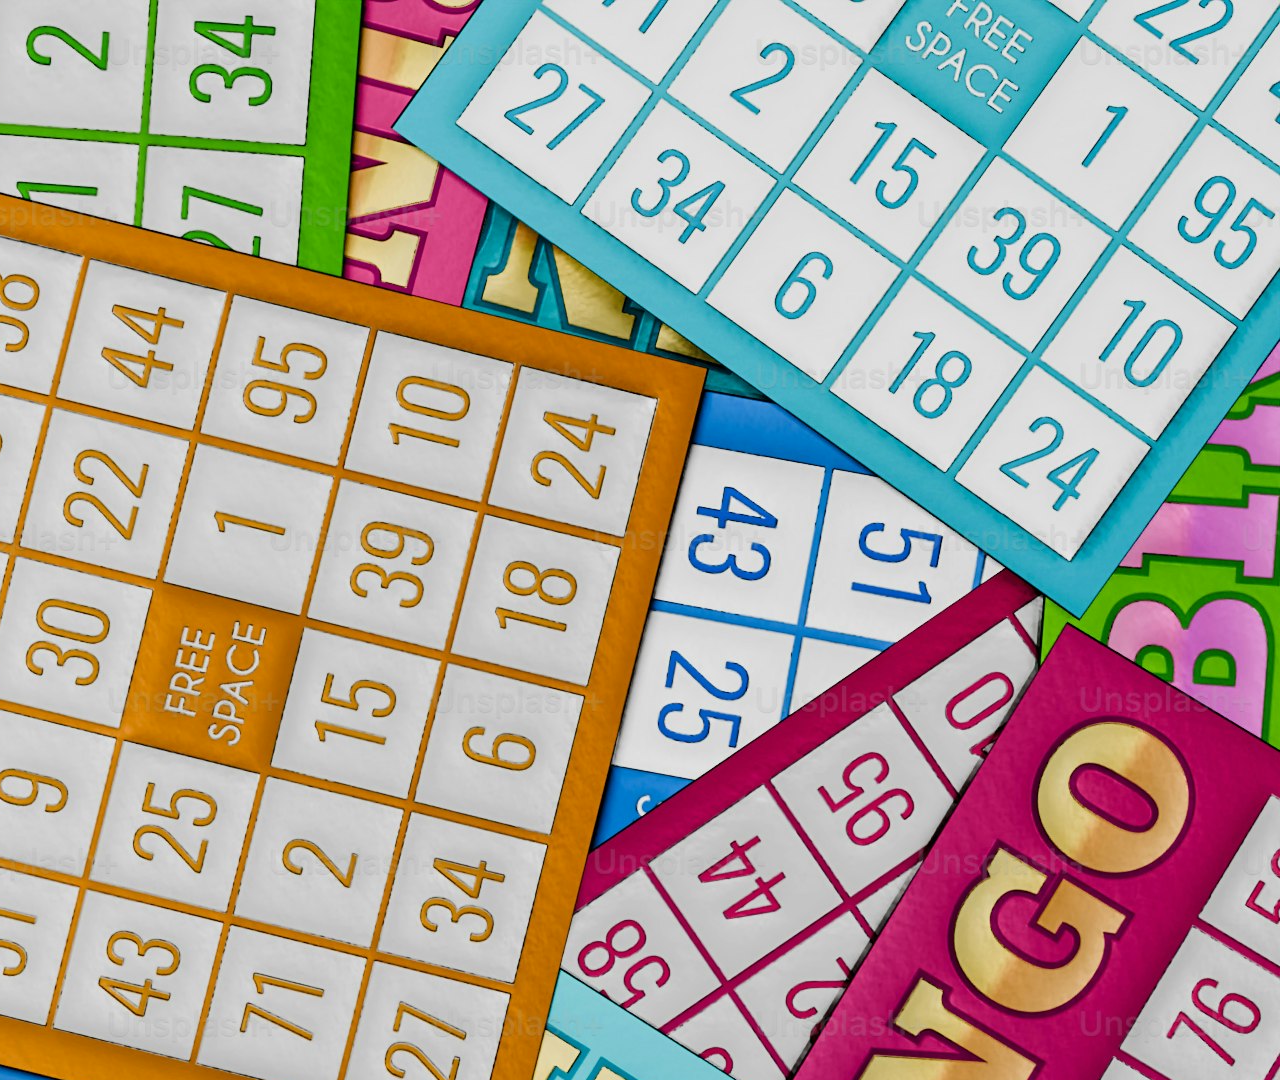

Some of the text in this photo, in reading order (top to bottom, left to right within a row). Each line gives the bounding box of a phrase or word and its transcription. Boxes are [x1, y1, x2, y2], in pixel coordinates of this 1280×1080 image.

[189, 16, 276, 106] 34
[905, 16, 1018, 113] SPACE
[504, 63, 605, 150] 27
[631, 149, 725, 244] 34
[850, 122, 936, 209] 15
[967, 208, 1061, 300] 39
[1178, 176, 1275, 269] 95
[101, 305, 184, 388] 44
[889, 332, 972, 419] 18
[1099, 300, 1183, 387] 10
[389, 376, 470, 447] 10
[999, 417, 1099, 511] 24
[214, 512, 286, 535] 1
[688, 487, 778, 581] 43
[851, 522, 943, 604] 51
[495, 561, 577, 632] 18
[26, 599, 110, 686] 30
[164, 628, 215, 716] FREE
[208, 622, 266, 746] SPACE
[315, 673, 396, 745] 15
[658, 651, 749, 748] 25
[133, 783, 217, 873] 25
[818, 752, 914, 846] 95
[420, 858, 505, 942] 34
[698, 836, 785, 919] 44
[240, 973, 324, 1040] 71
[1167, 978, 1261, 1066] 76
